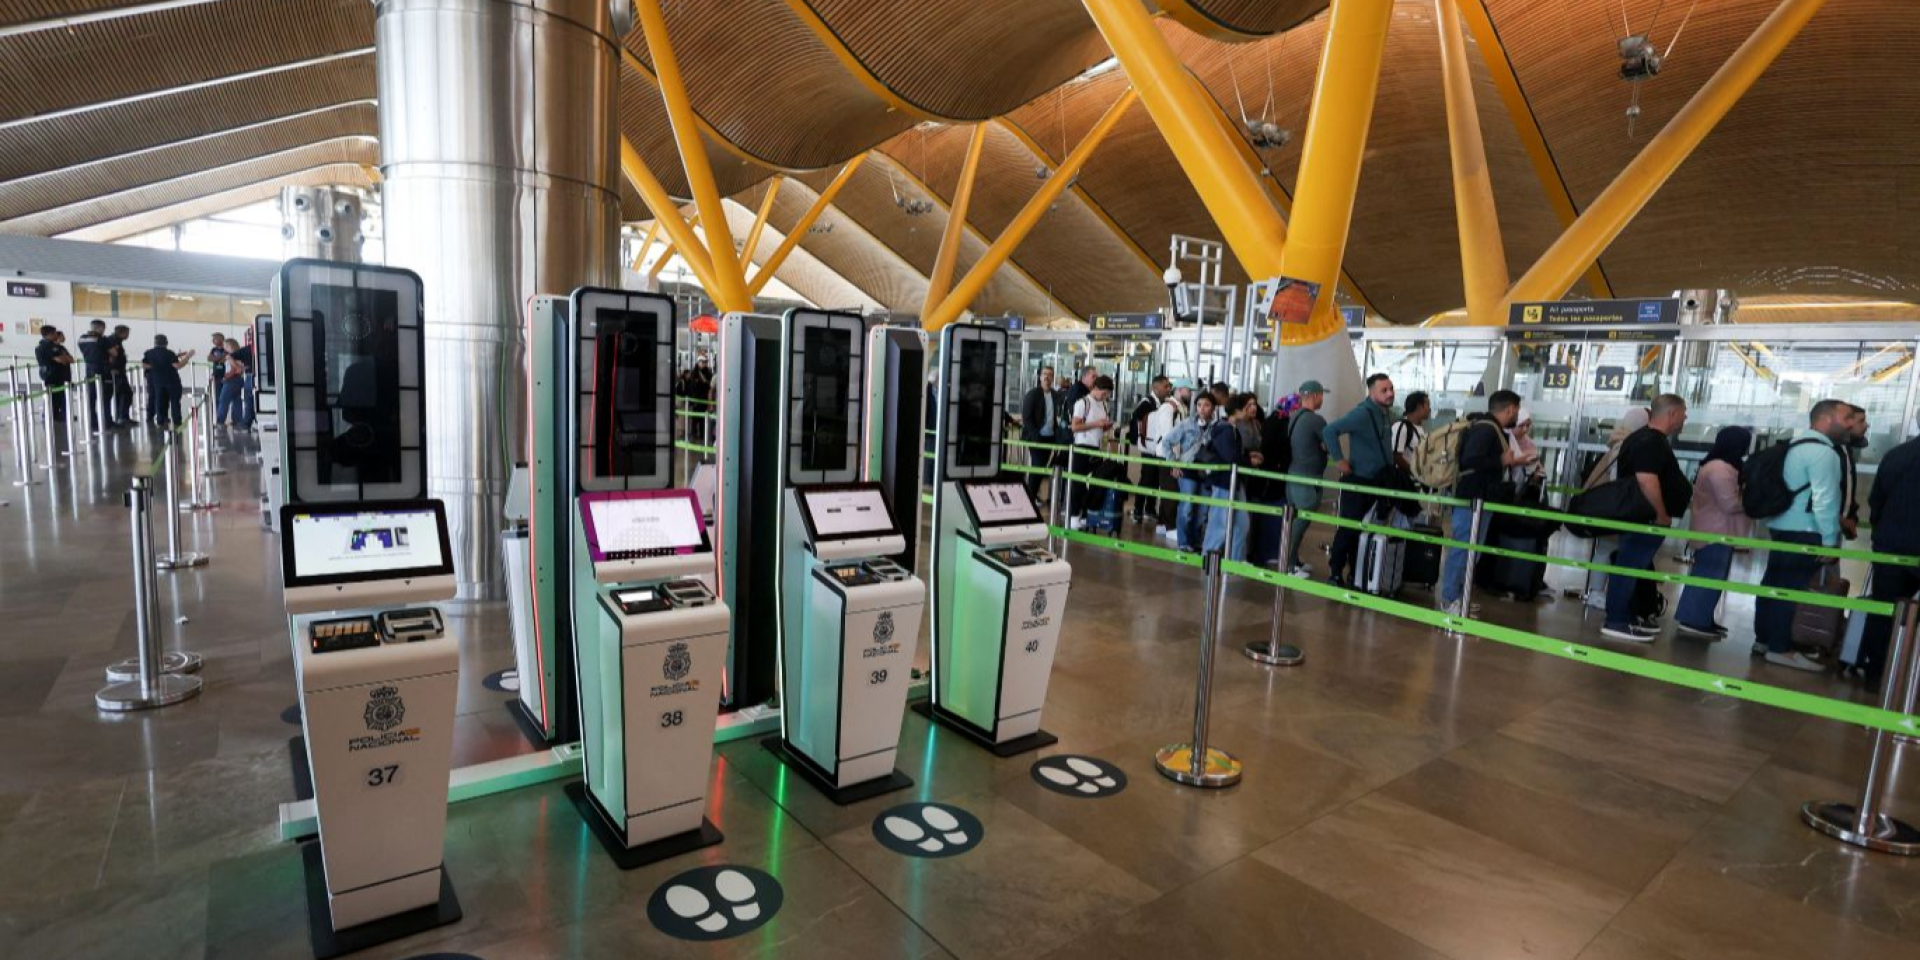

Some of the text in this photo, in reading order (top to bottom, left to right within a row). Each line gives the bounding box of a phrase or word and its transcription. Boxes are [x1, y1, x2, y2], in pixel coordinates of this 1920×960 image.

[1560, 305, 1595, 315] passports
[1549, 314, 1623, 323] Todos los pasaportes
[1547, 372, 1567, 386] 13
[1598, 373, 1620, 388] 14
[1025, 639, 1039, 653] 40
[870, 669, 888, 685] 39
[661, 710, 683, 728] 38
[348, 736, 421, 753] NACIONAL
[367, 764, 399, 787] 37
